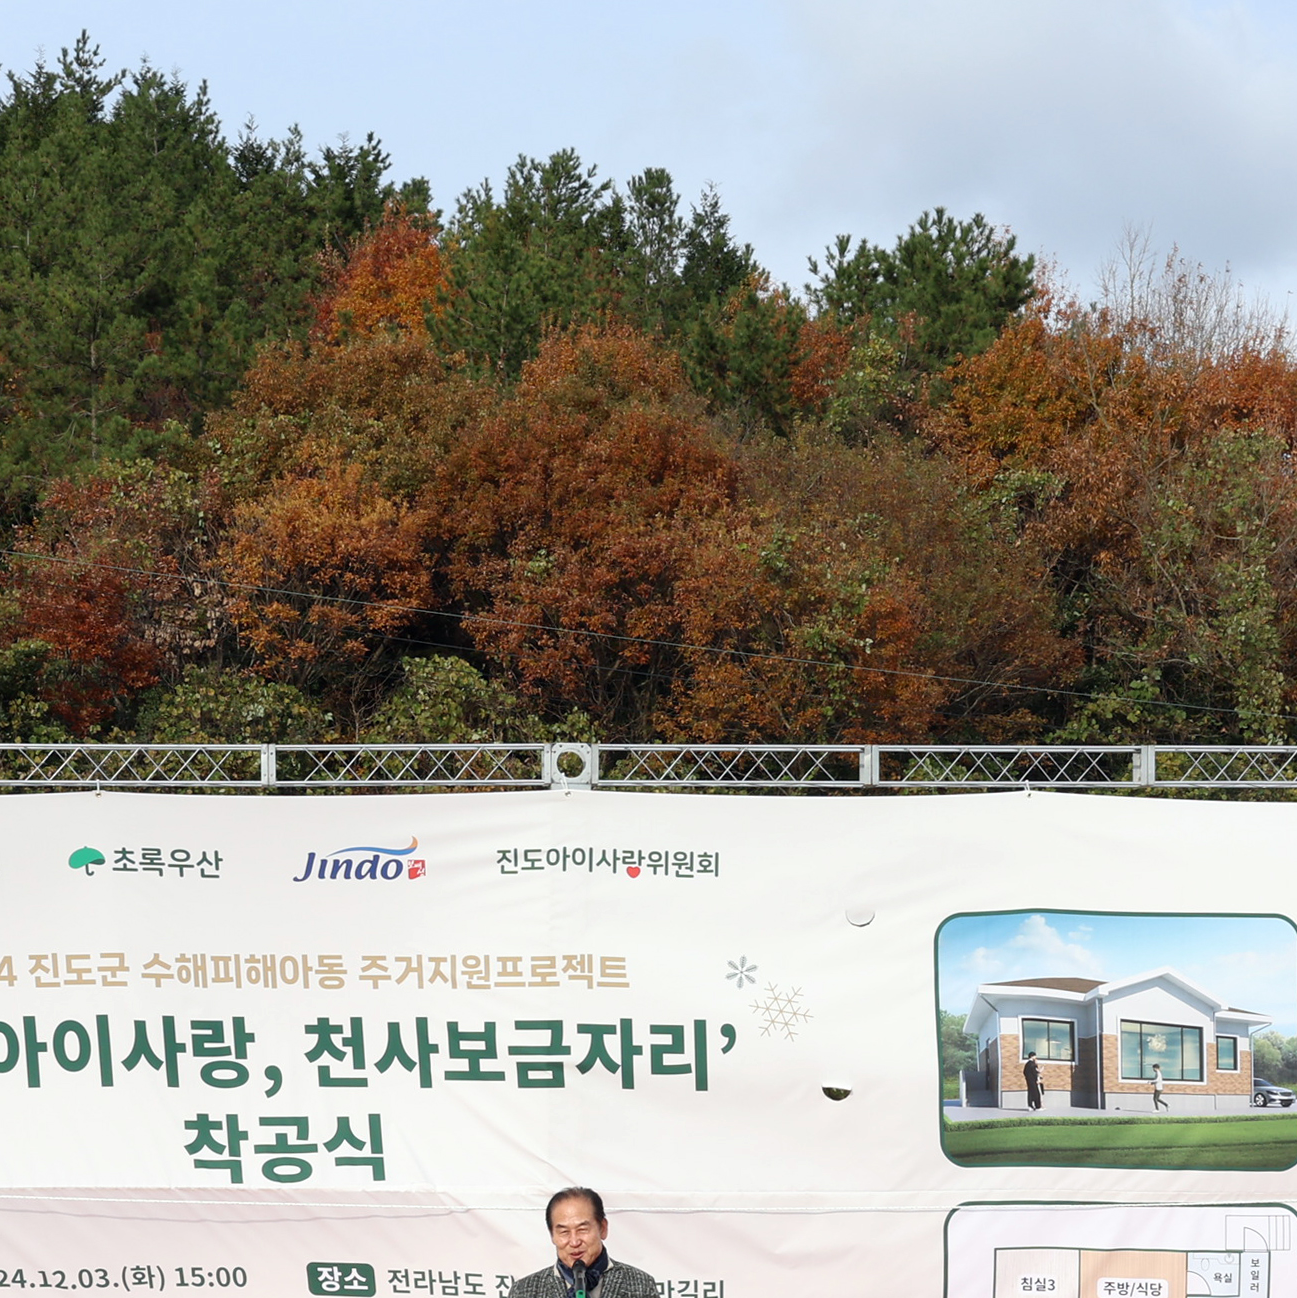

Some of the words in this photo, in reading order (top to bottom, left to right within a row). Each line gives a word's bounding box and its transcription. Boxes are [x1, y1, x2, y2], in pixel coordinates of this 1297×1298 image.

[112, 846, 224, 879] 초록우산
[292, 852, 404, 883] Jindo
[496, 846, 720, 879] 진도아이사랑위원회
[28, 953, 130, 988] 진도군
[140, 953, 348, 990] 수해피해아동
[358, 953, 630, 990] 주거지원프로젝트
[183, 1113, 386, 1185] 착공식
[174, 1266, 248, 1288] 15:00
[316, 1266, 369, 1292] 장소
[387, 1268, 486, 1297] 전라남도
[1020, 1277, 1056, 1292] 침실3
[1103, 1281, 1163, 1298] 주방/식당
[1213, 1272, 1233, 1283] 욕실
